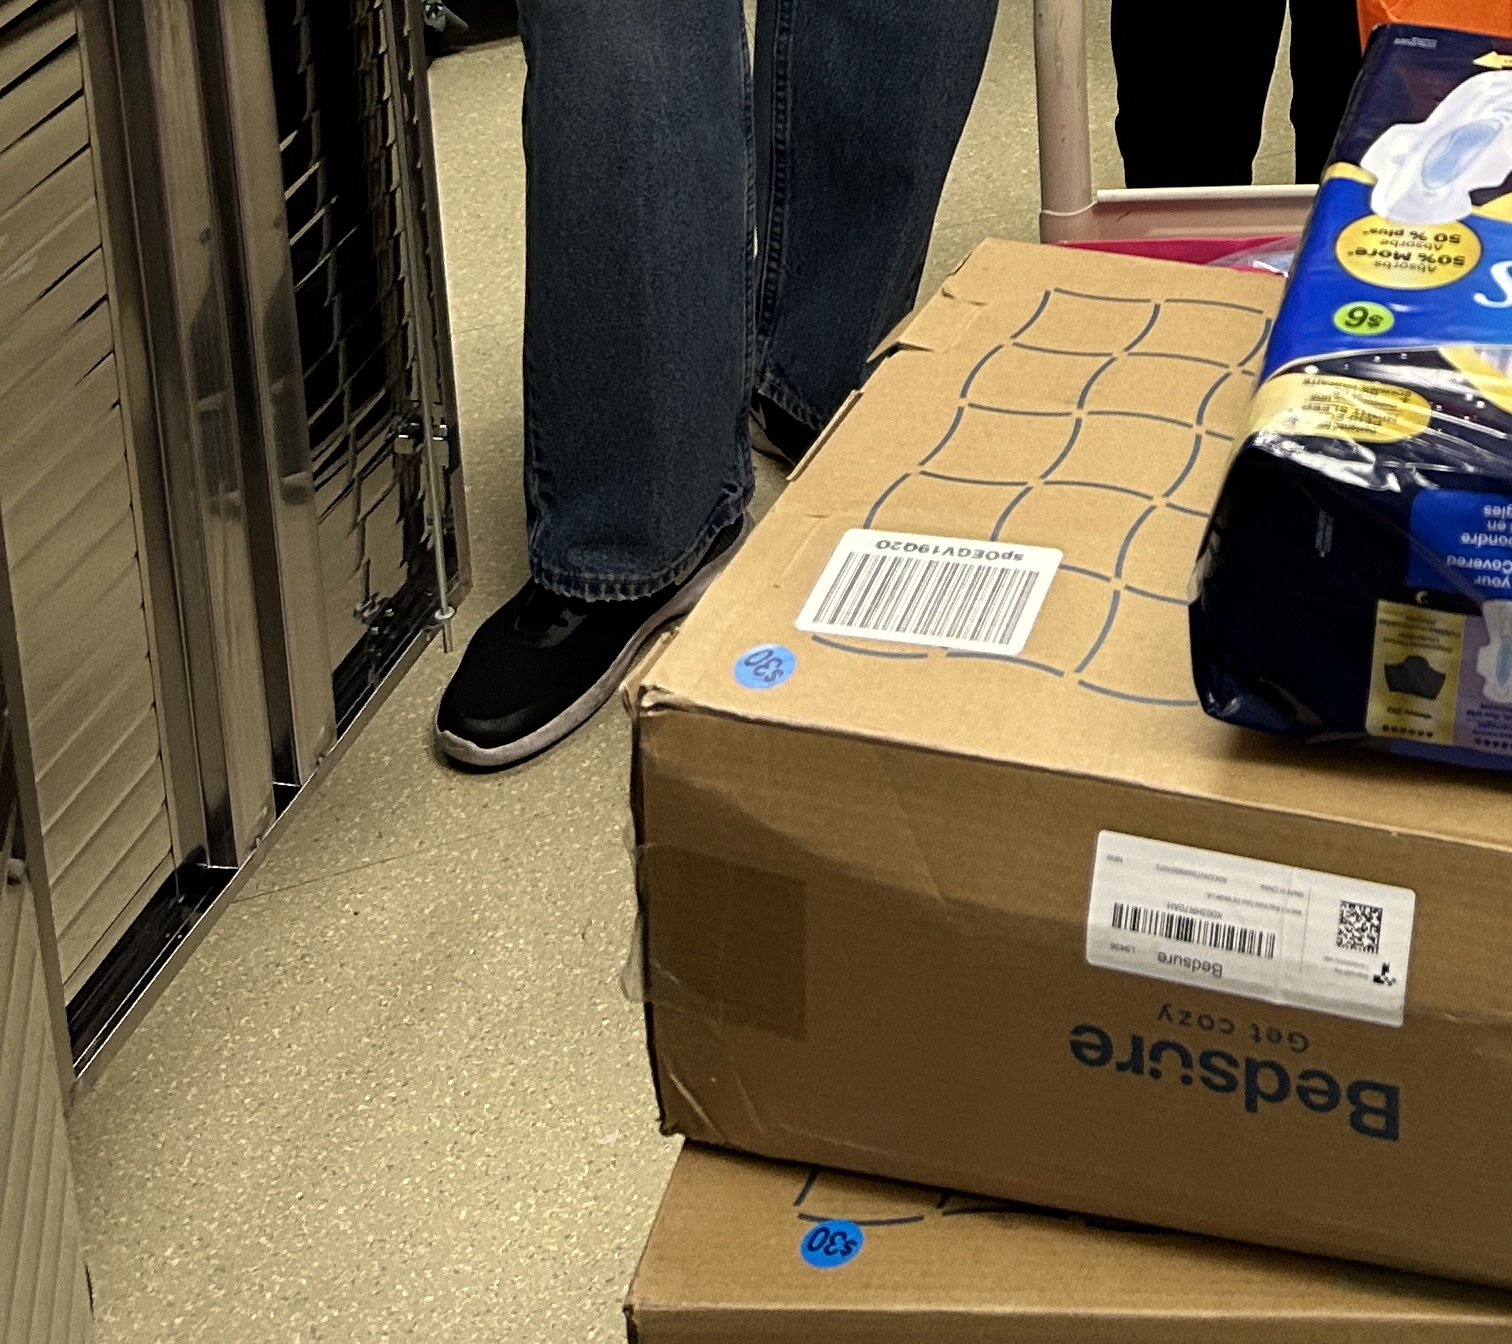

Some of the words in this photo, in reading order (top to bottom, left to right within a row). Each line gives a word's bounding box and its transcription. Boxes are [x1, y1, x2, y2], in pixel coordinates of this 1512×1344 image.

[1379, 238, 1443, 252] Absorbe
[1418, 251, 1466, 267] 50%
[1344, 307, 1385, 329] $6
[1486, 520, 1507, 533] en
[1446, 554, 1512, 574] Covered
[1474, 572, 1512, 588] your
[1157, 951, 1223, 979] Bedsure
[1155, 1003, 1236, 1036] cozy
[1249, 1024, 1309, 1055] Get
[806, 1226, 858, 1257] $30
